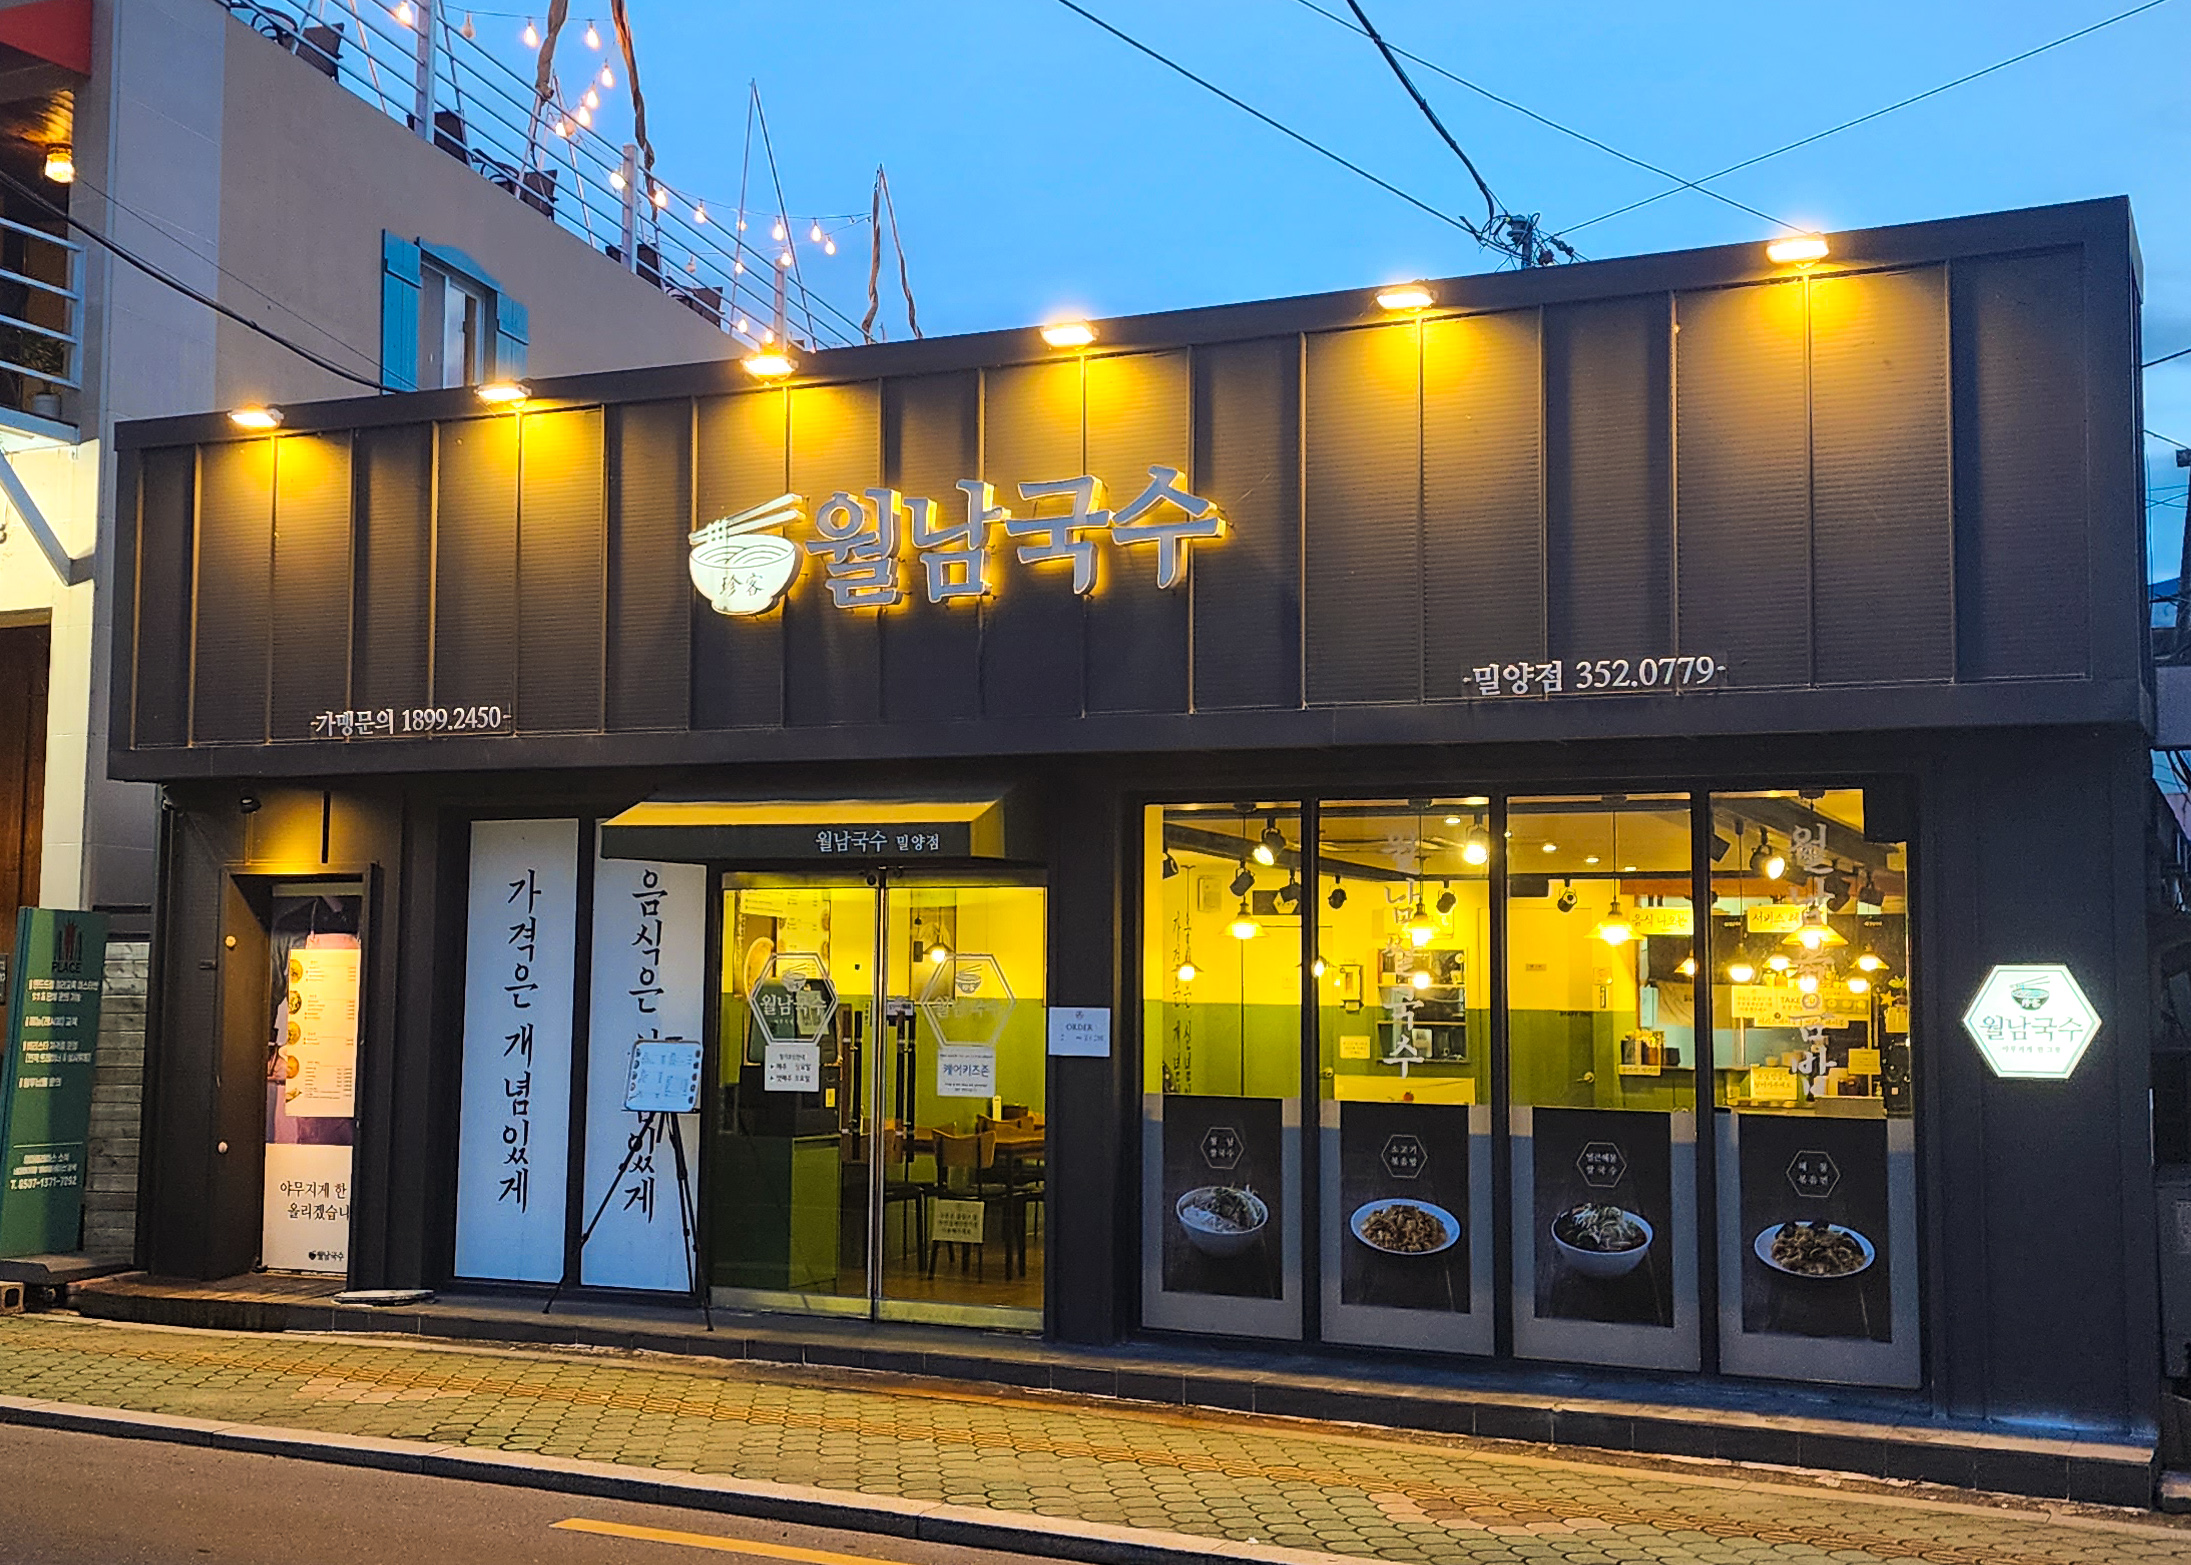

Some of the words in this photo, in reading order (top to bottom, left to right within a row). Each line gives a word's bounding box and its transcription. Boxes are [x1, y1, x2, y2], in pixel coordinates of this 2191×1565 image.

[805, 464, 1227, 610] 월남국수
[815, 829, 889, 853] 월남국수
[896, 833, 940, 851] 밀양점
[503, 868, 543, 1010] 가격은
[628, 868, 669, 1013] 음식은
[760, 993, 827, 1016] 월남국수
[1979, 1015, 2084, 1043] 월남국수
[943, 1063, 991, 1078] 케어키즈존
[497, 1022, 536, 1215] 개념있게
[279, 1180, 331, 1199] 야무지게
[334, 1182, 348, 1200] 한
